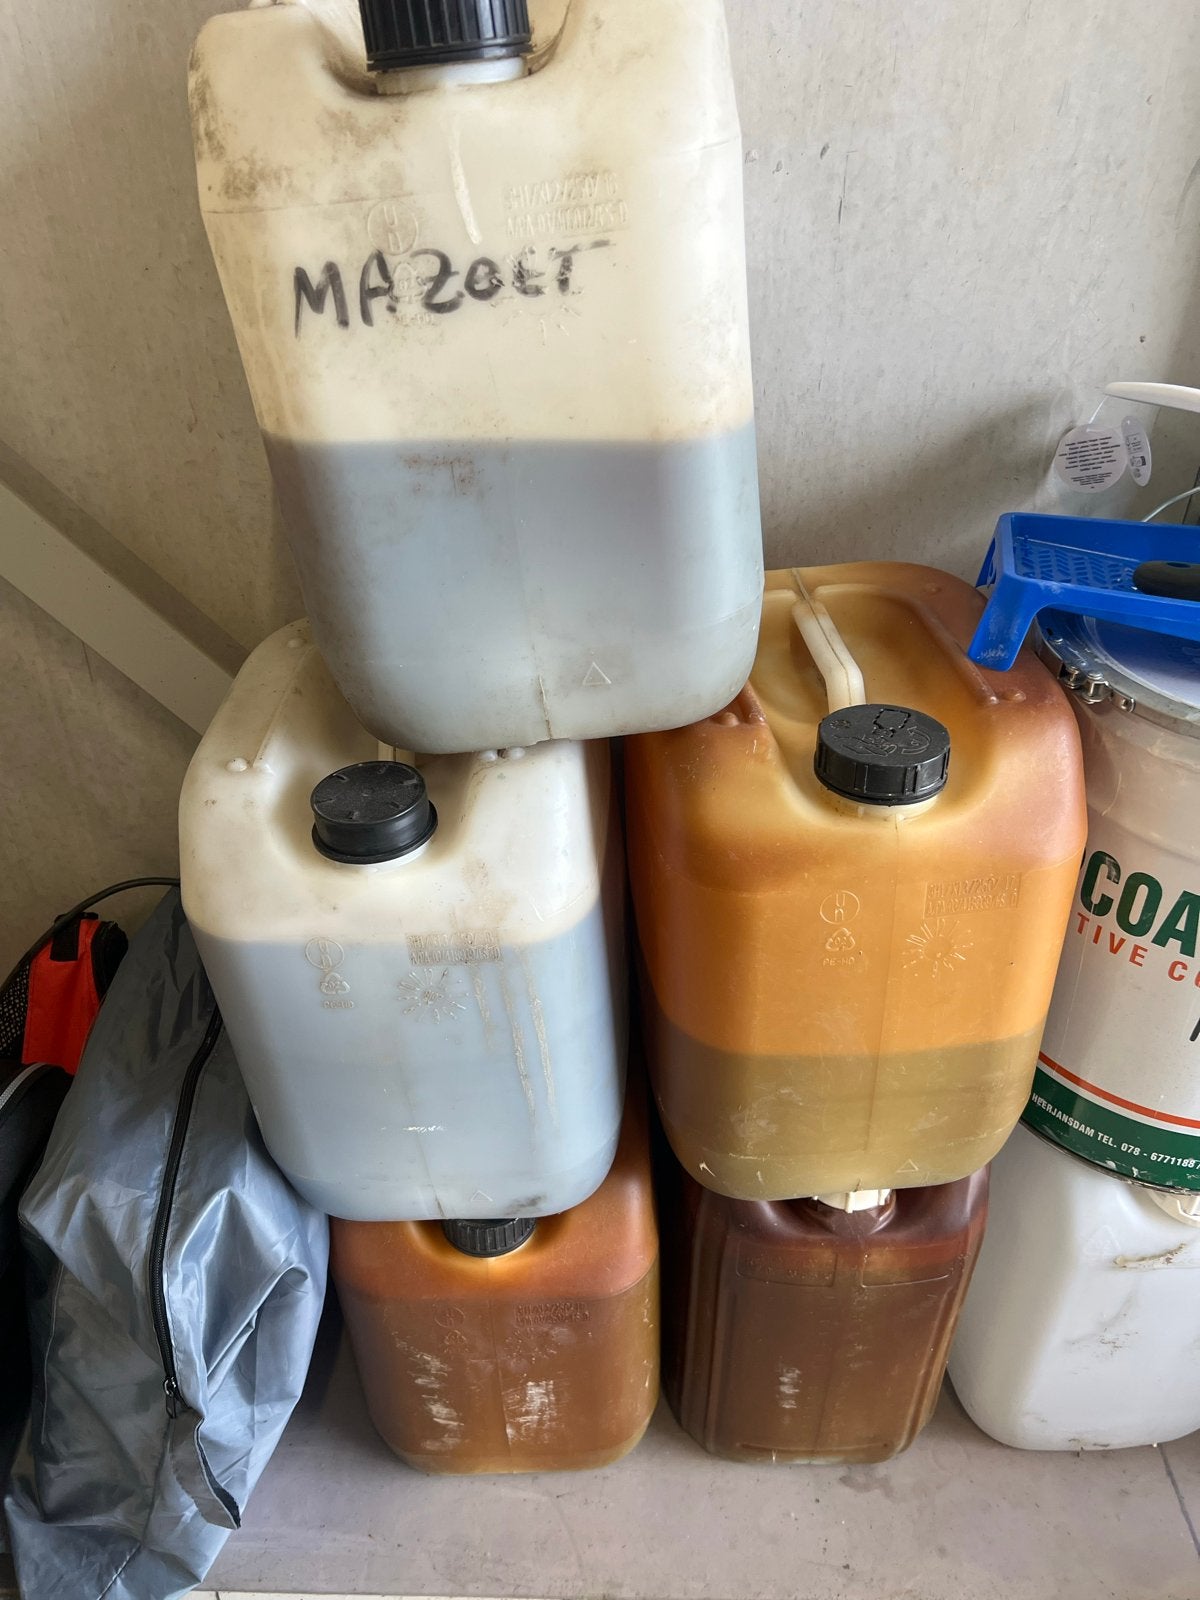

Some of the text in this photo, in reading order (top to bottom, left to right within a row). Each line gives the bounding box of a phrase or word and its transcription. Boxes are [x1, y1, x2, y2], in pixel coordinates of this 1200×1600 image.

[1080, 850, 1200, 958] COA
[1031, 1093, 1095, 1138] HEERJANSDAM
[1098, 1132, 1117, 1148] TEL.
[1121, 1142, 1141, 1156] 078
